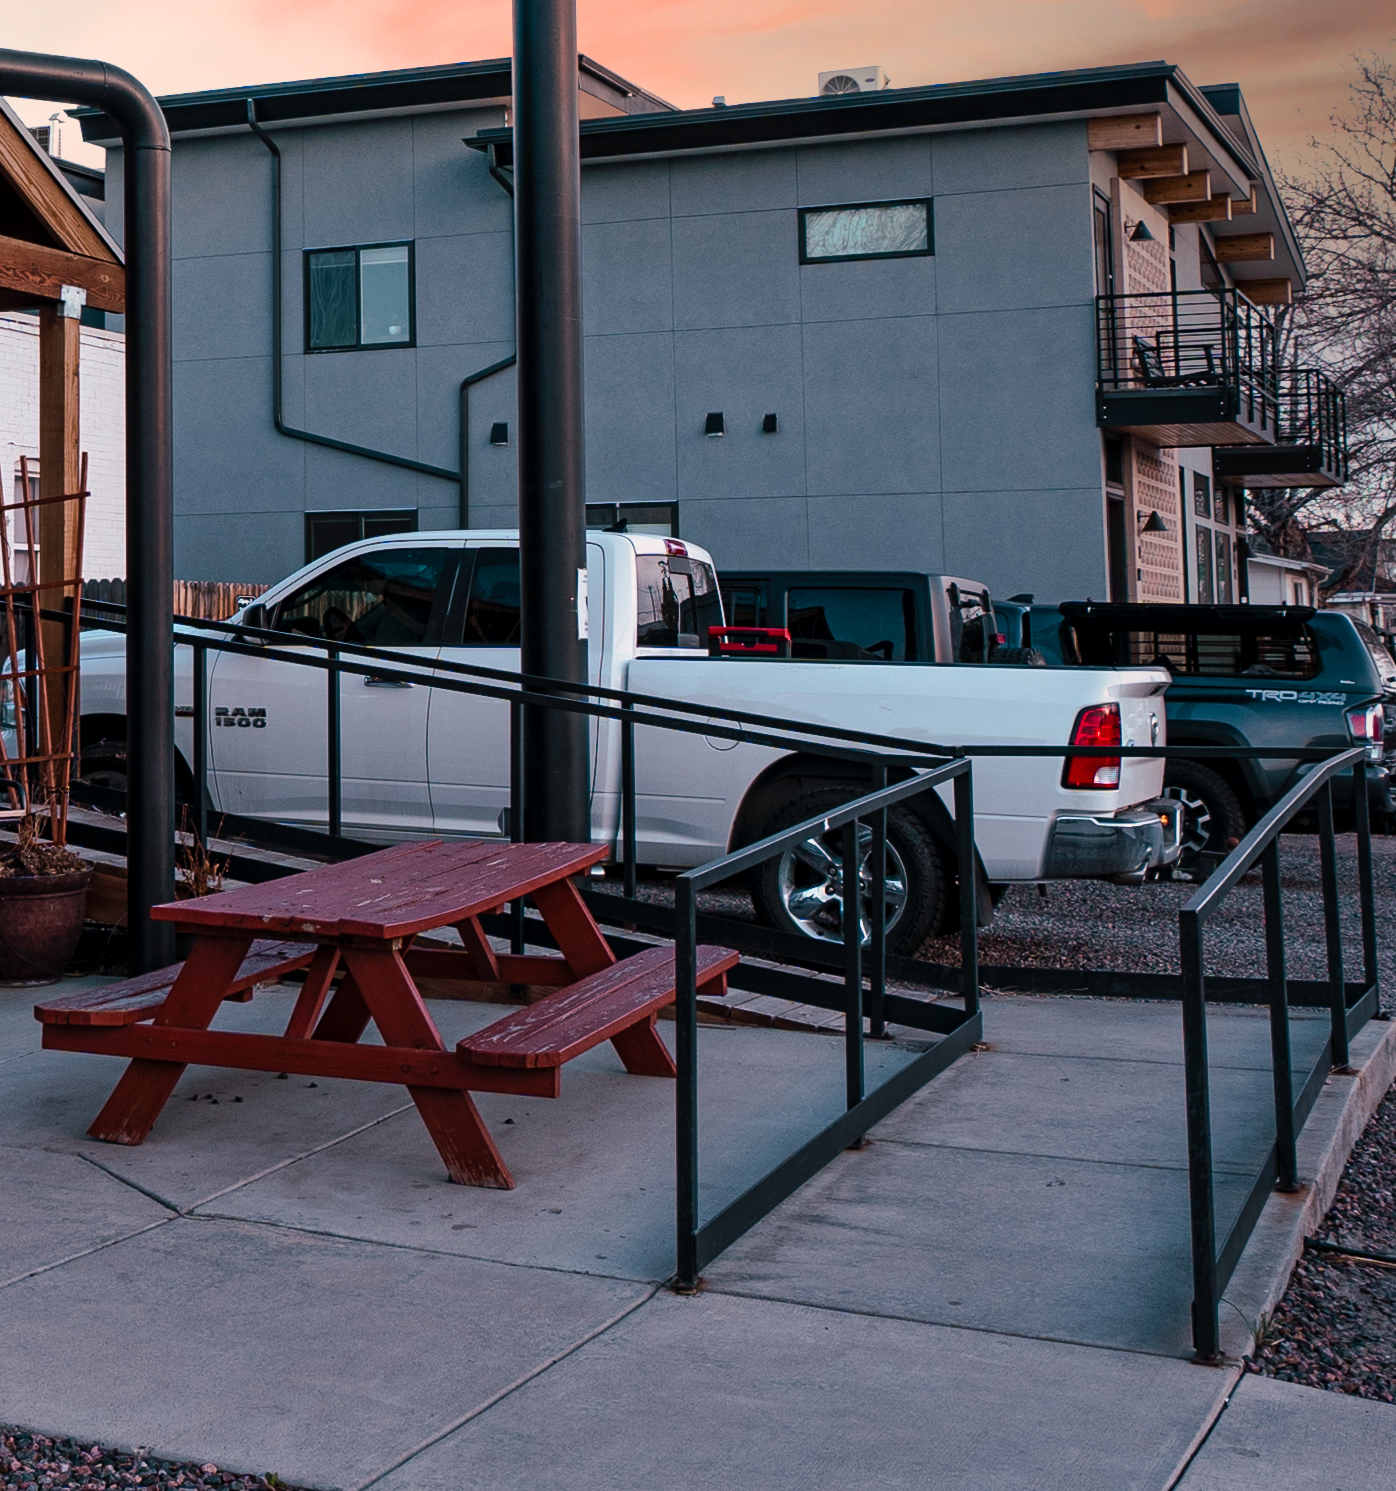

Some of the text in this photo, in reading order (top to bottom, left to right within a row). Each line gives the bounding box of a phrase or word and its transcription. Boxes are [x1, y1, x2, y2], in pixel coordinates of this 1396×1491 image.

[1245, 689, 1297, 702] TRD
[215, 706, 267, 717] RAM
[215, 717, 267, 728] 1500
